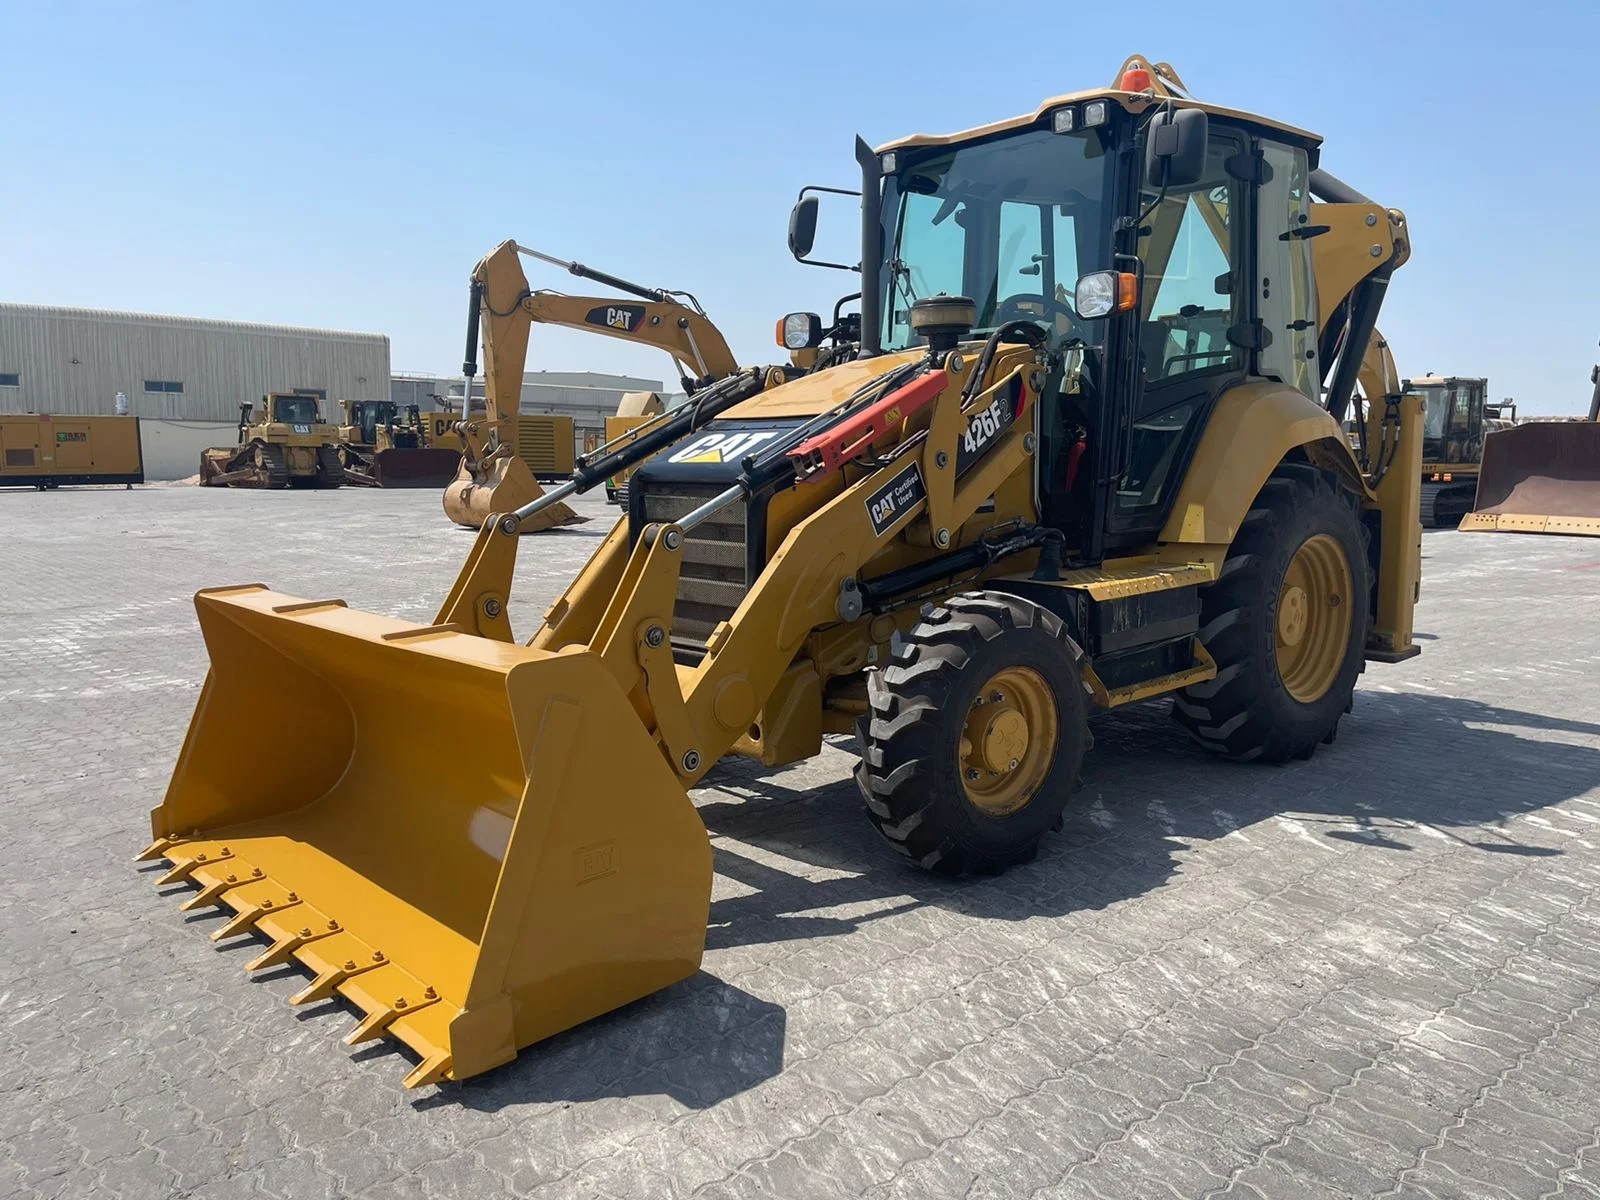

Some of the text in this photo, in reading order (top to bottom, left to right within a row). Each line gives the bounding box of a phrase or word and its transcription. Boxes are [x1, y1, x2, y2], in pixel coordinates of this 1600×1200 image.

[606, 307, 632, 330] CAT
[293, 424, 310, 433] CAT
[964, 398, 1012, 453] 426F2
[667, 432, 779, 463] CAT
[894, 472, 919, 496] Certified
[871, 491, 896, 524] CAT
[897, 489, 913, 506] Used
